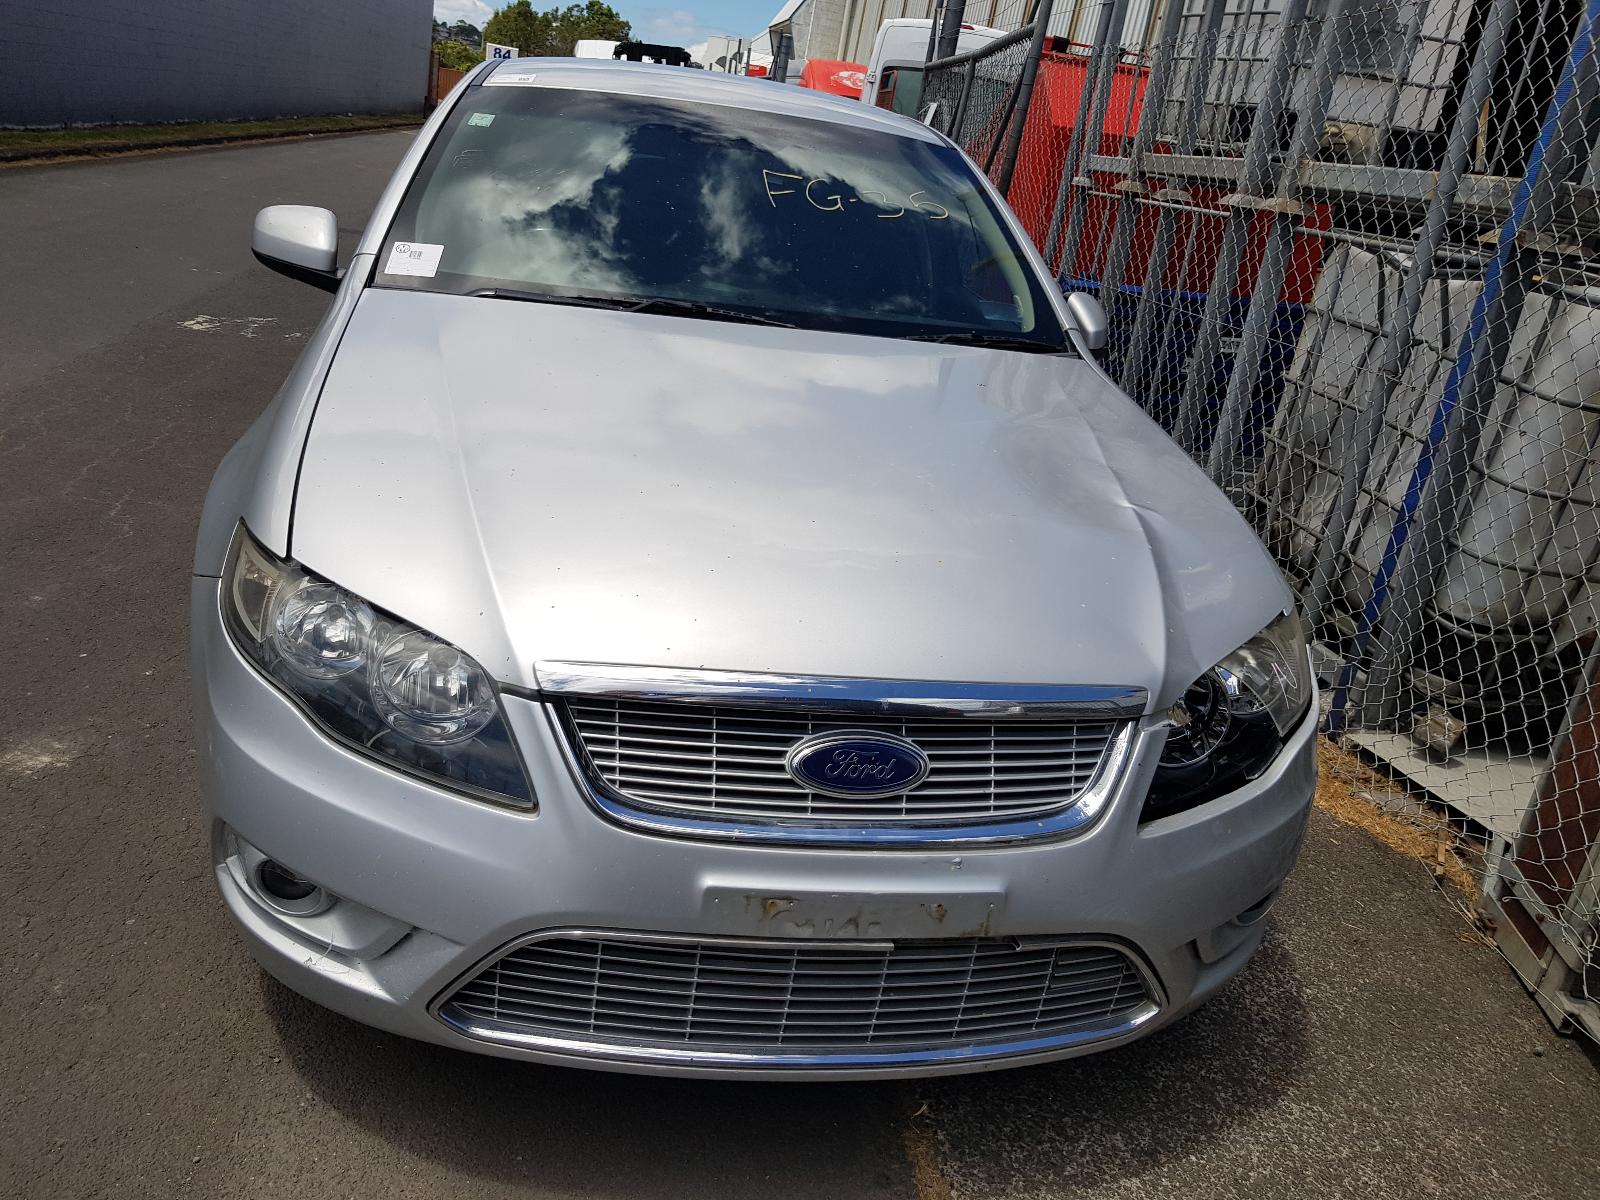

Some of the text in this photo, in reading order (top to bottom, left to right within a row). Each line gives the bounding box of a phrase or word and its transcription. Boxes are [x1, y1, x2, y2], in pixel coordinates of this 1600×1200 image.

[493, 47, 512, 59] 84
[763, 169, 949, 219] FG-35
[824, 749, 897, 780] Ford
